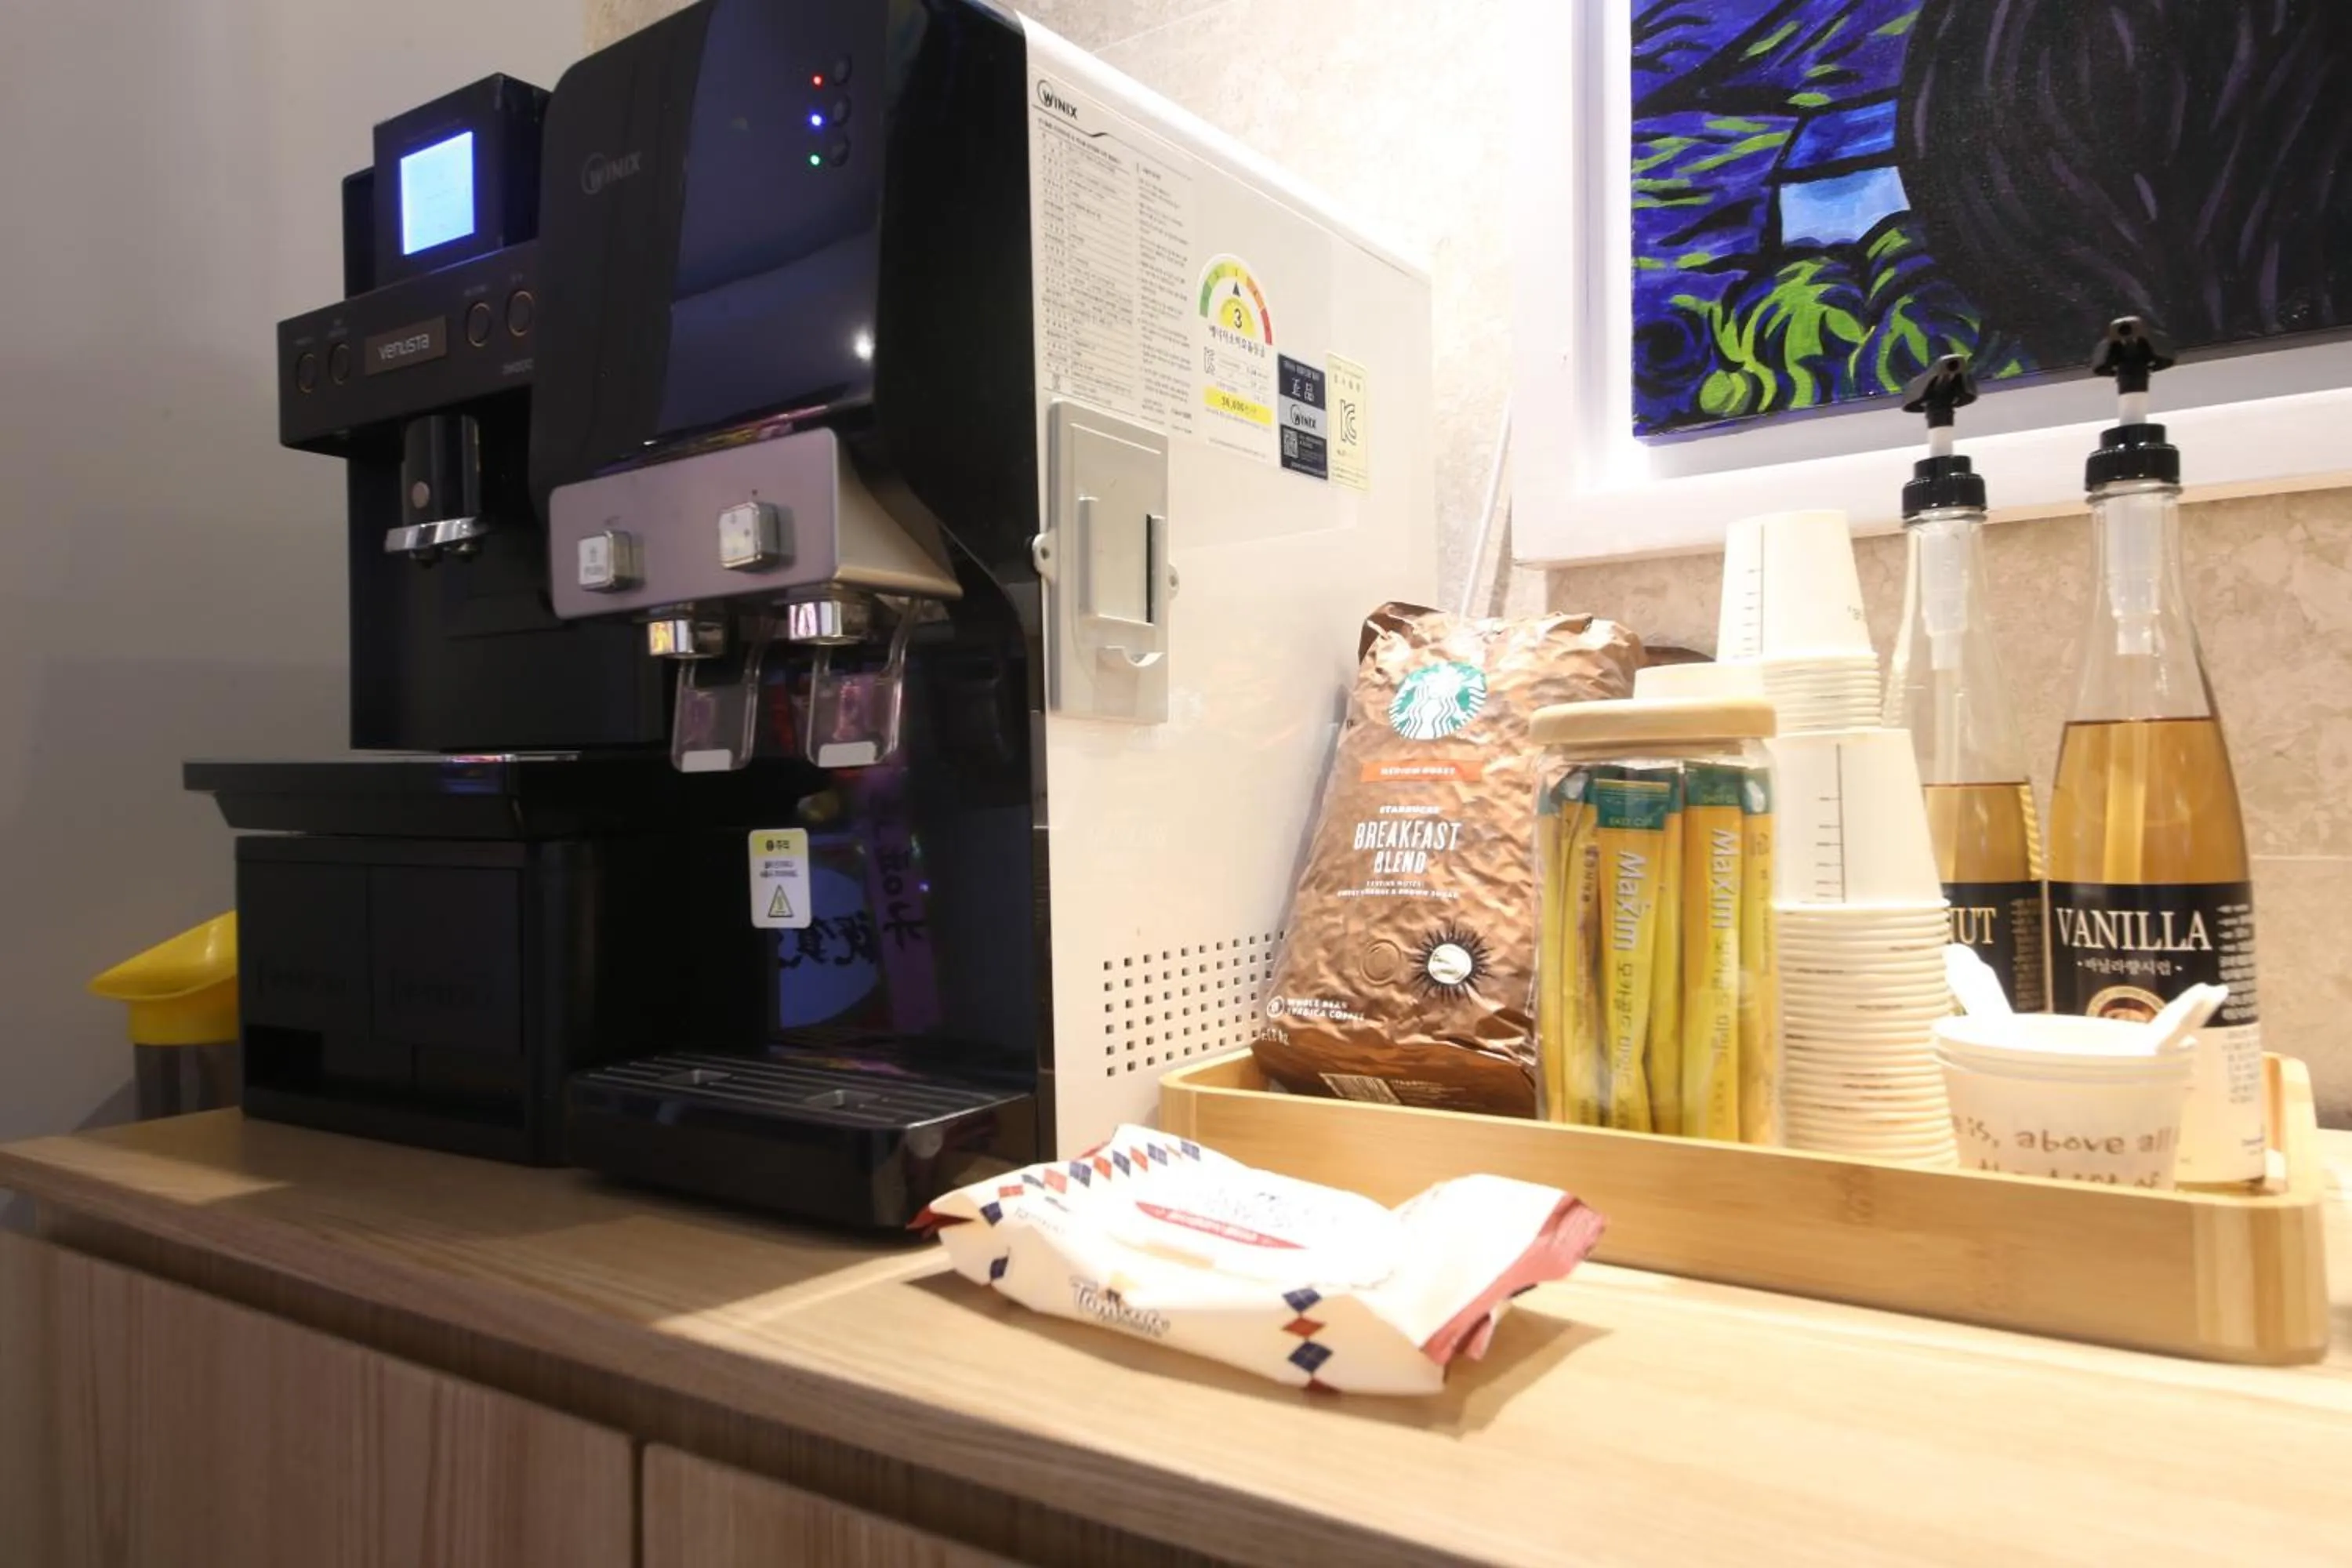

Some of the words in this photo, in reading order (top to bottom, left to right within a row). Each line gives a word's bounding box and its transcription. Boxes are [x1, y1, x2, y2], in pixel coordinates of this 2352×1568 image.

[1036, 79, 1079, 120] WINIX
[581, 151, 641, 194] WINIX
[1233, 307, 1243, 328] 3
[1290, 404, 1317, 430] WINIX
[1379, 805, 1440, 814] STARBUCKS
[1352, 821, 1462, 851] BREAKFAST
[1374, 850, 1428, 874] BLEND
[1709, 827, 1740, 929] Maxim
[1613, 850, 1648, 952] Maxim
[2055, 907, 2213, 951] VANILLA
[1287, 998, 1319, 1007] WHOLE
[2015, 1129, 2125, 1155] above
